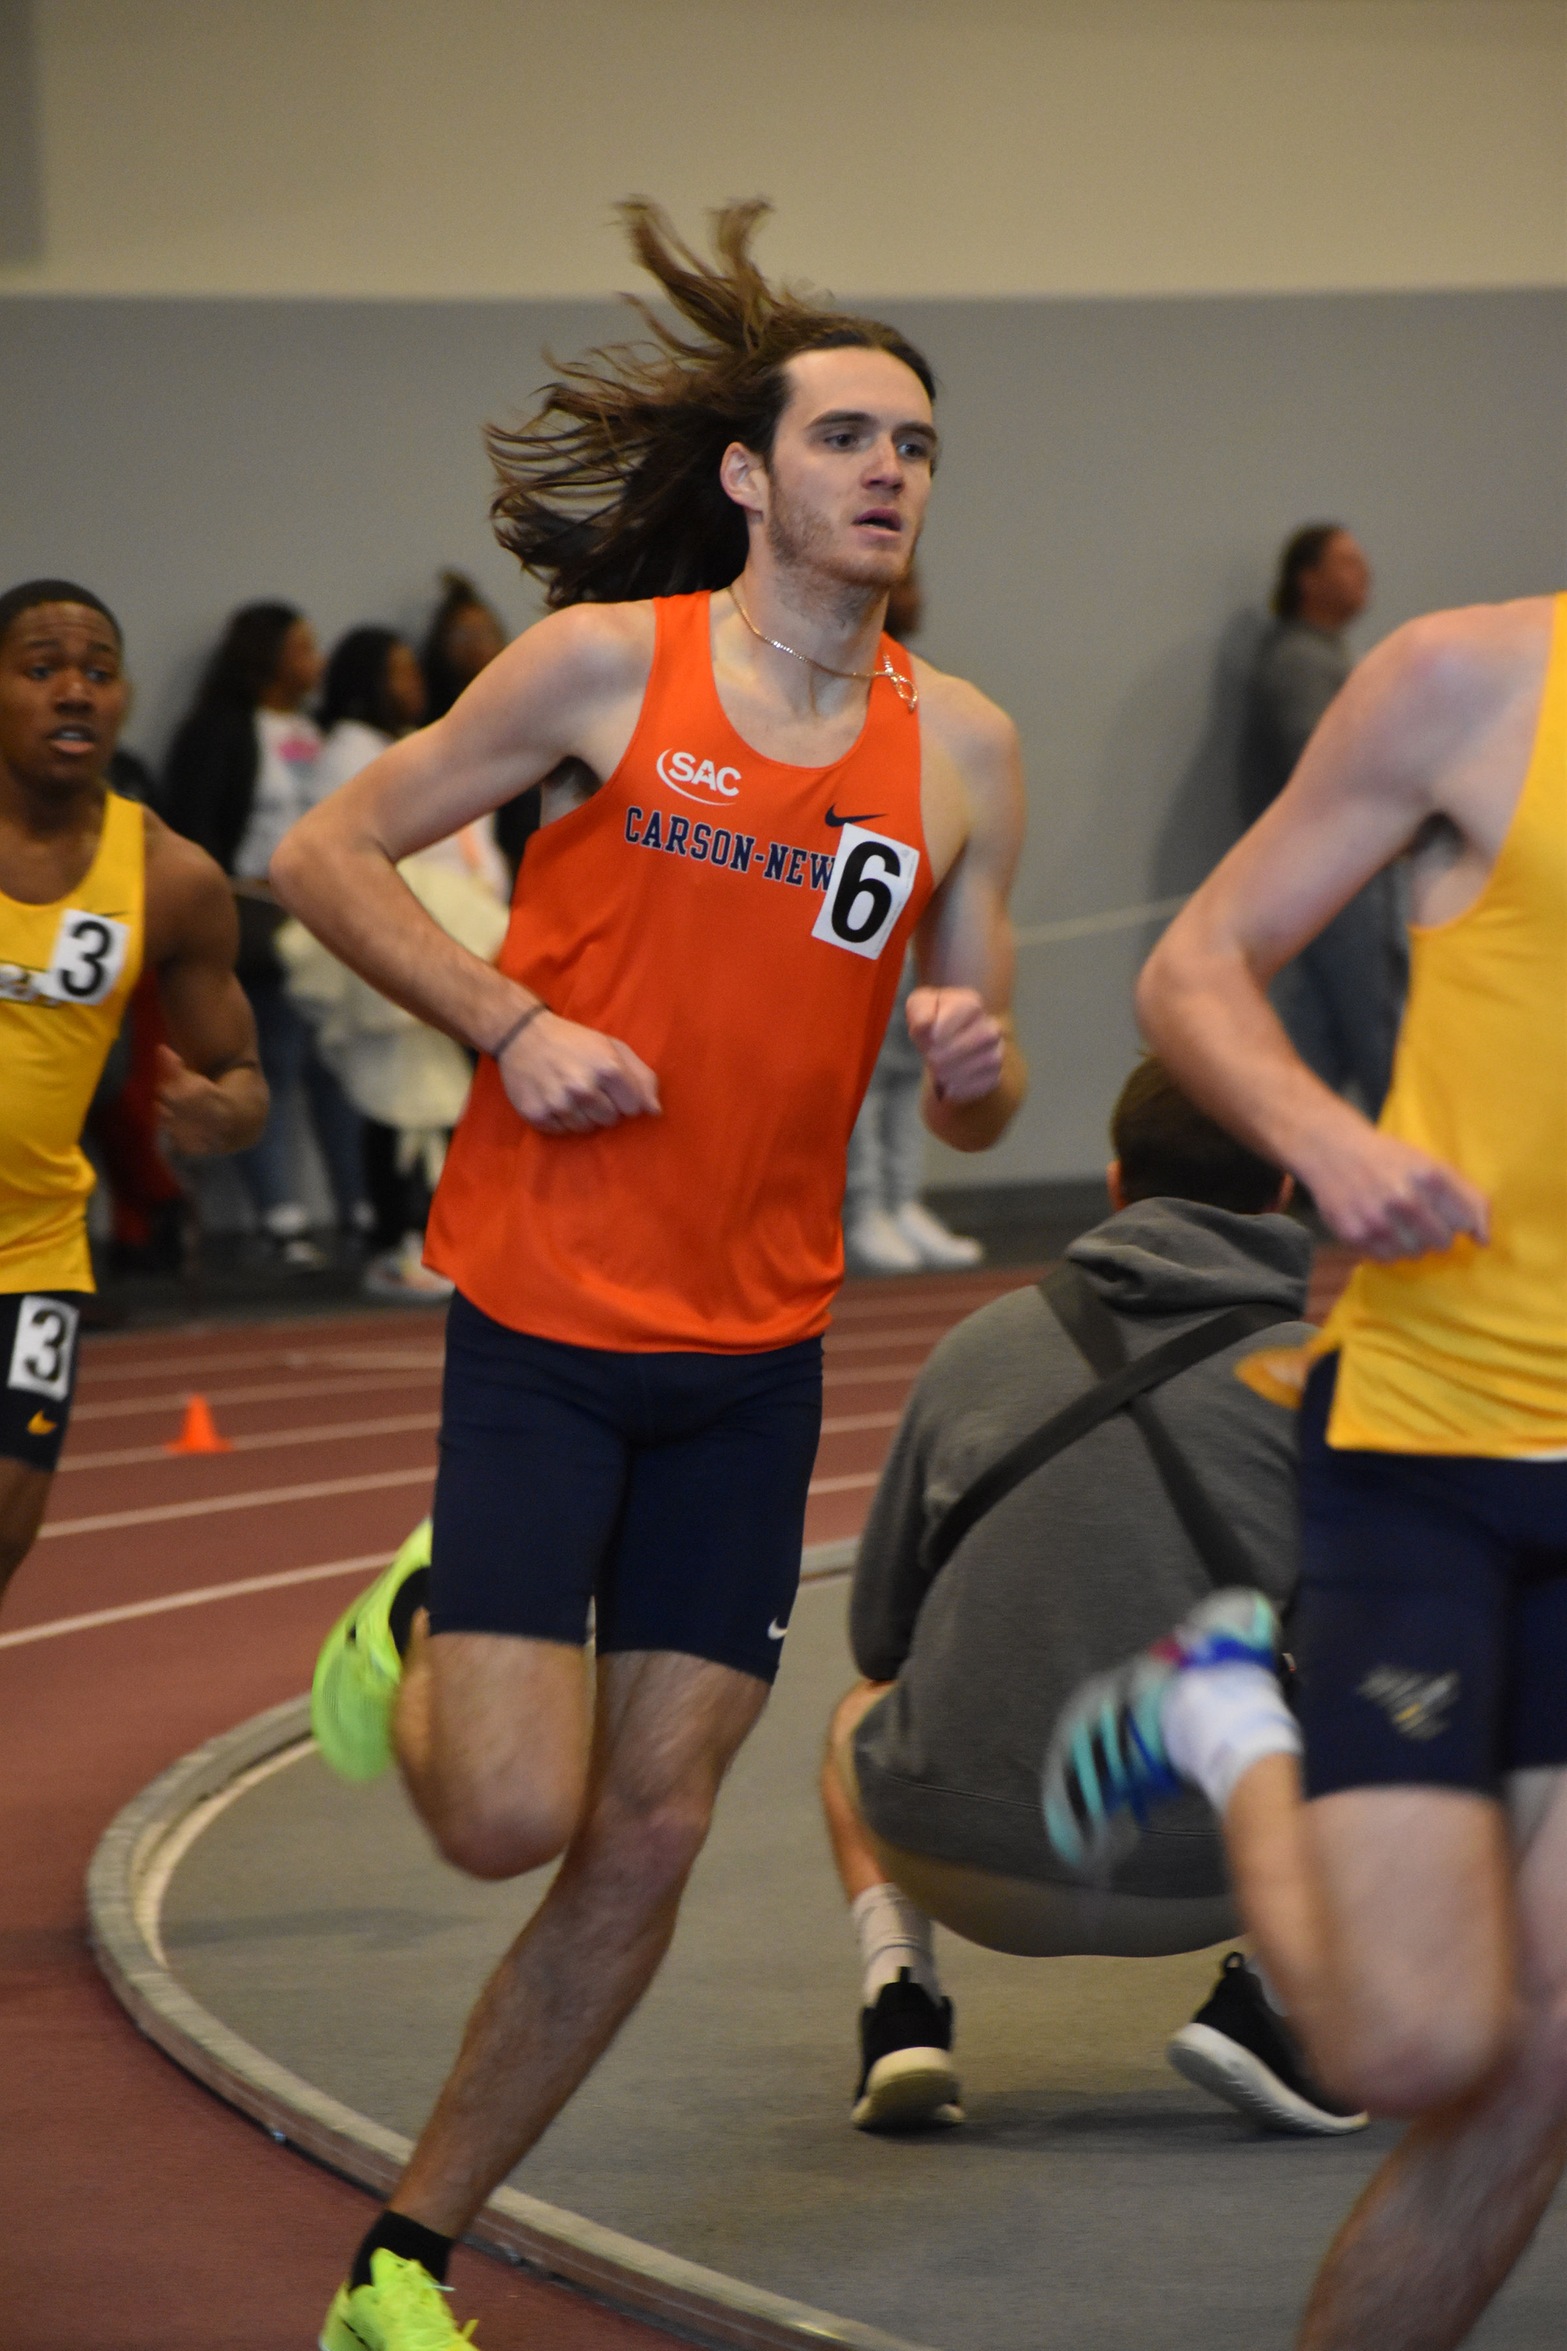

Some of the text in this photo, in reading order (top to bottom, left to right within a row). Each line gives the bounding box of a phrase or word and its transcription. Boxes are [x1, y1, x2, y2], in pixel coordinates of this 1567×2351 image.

[667, 751, 742, 797] SAC
[831, 841, 901, 943] 6
[60, 920, 113, 997] 3
[24, 1309, 67, 1383] 3
